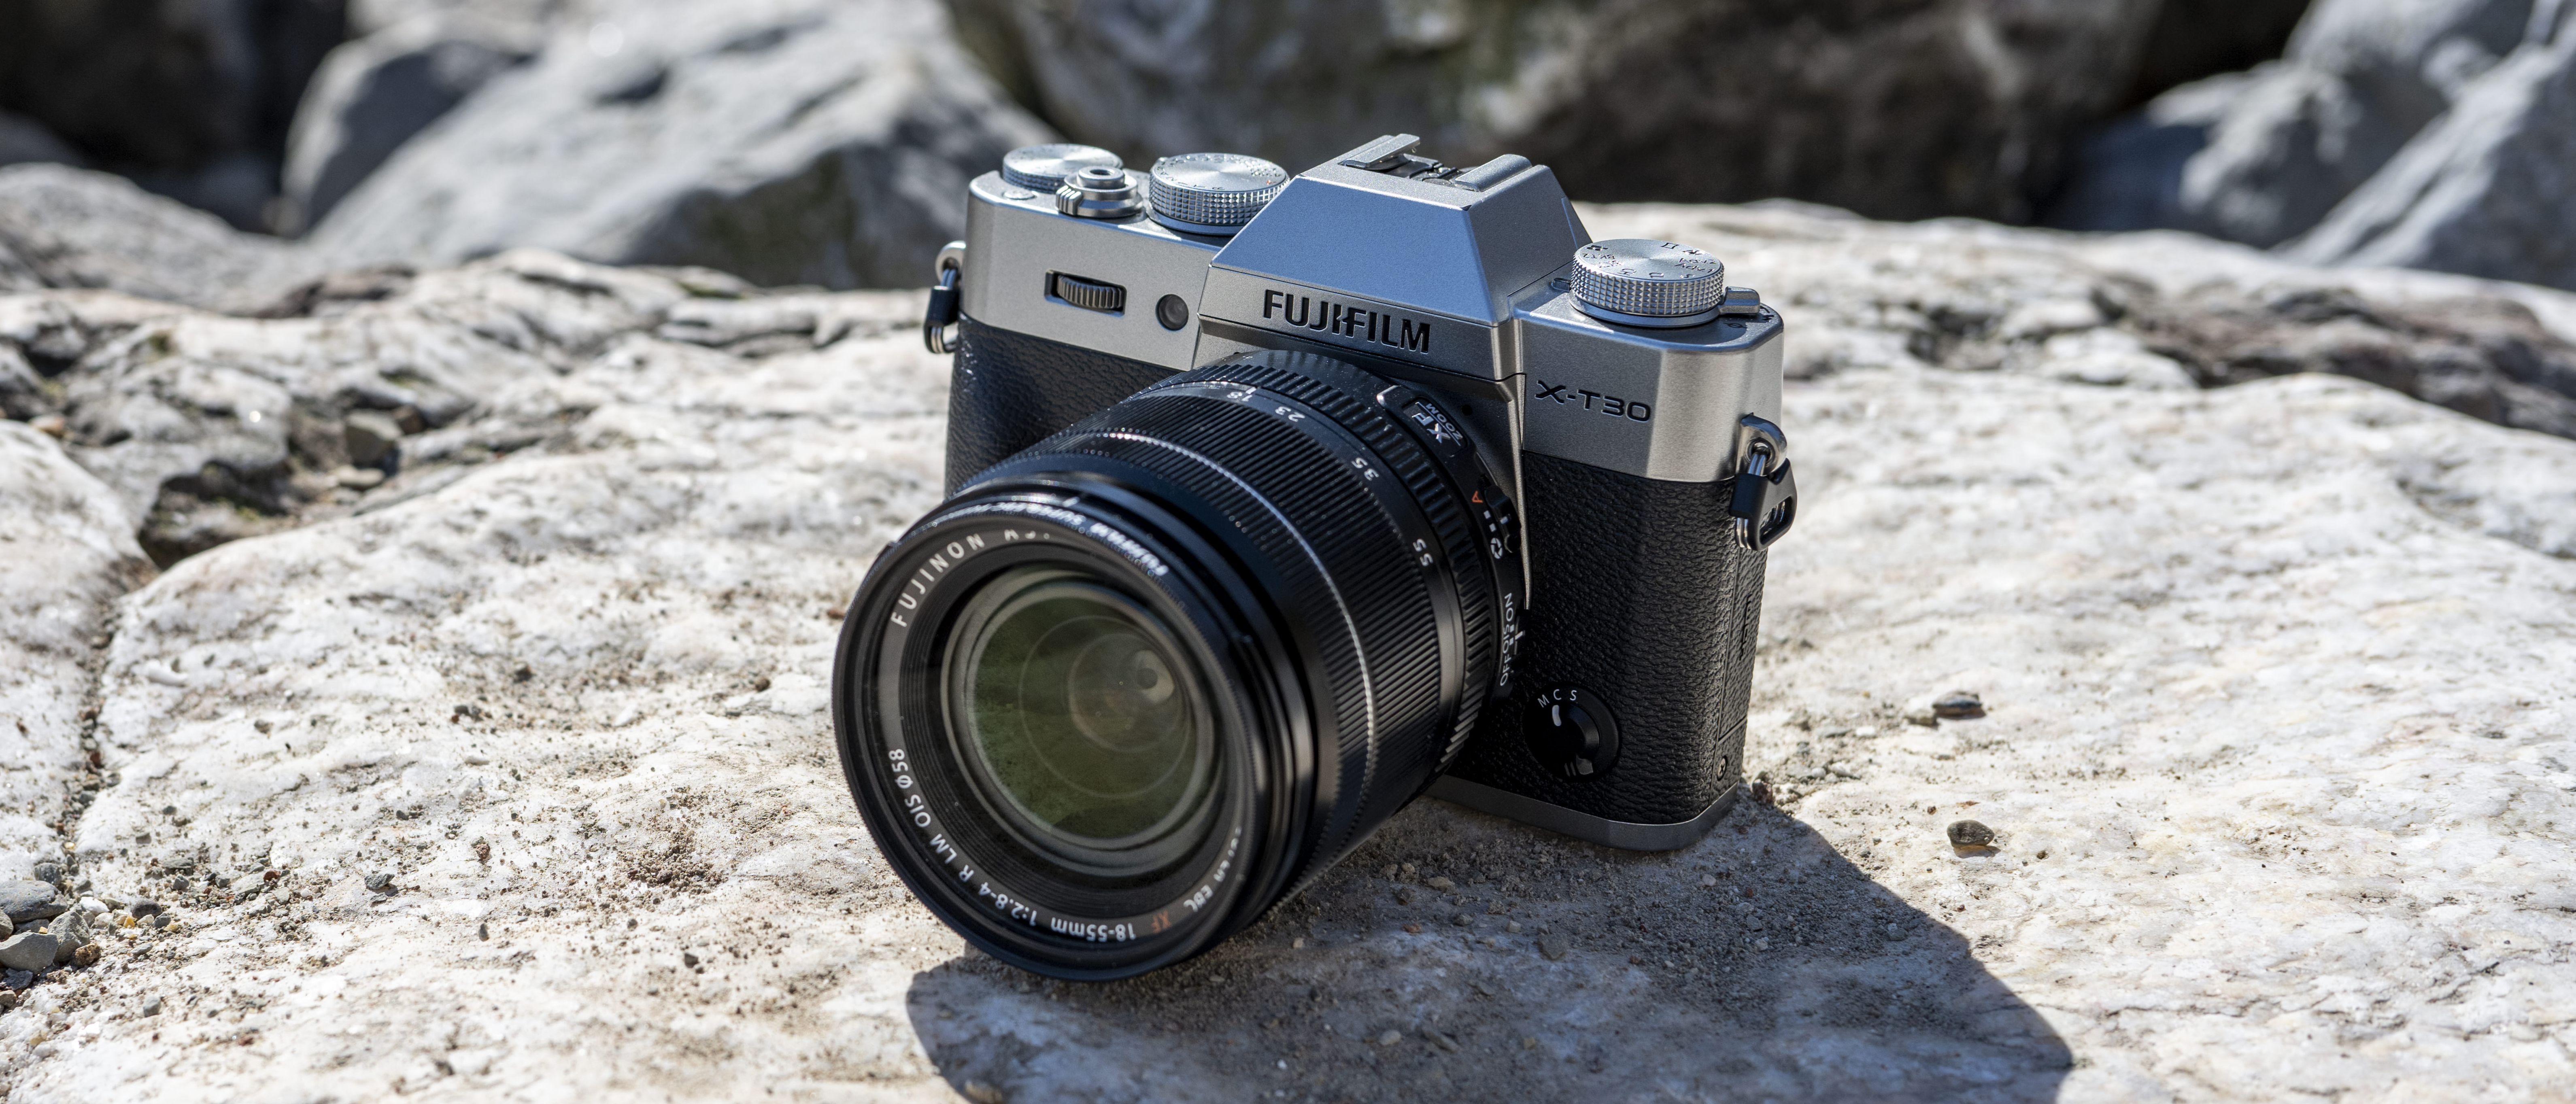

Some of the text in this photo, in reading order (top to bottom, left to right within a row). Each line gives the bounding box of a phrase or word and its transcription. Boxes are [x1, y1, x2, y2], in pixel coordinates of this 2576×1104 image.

[1263, 289, 1431, 354] FUJIFILM
[1275, 406, 1306, 422] 23
[1535, 380, 1651, 422] X-T30
[1411, 413, 1451, 444] XF
[1426, 403, 1463, 440] ZOOM
[1351, 456, 1379, 481] 35
[1472, 490, 1483, 503] A
[1413, 538, 1433, 567] 55
[891, 533, 985, 628] FUJINON
[1504, 592, 1513, 622] ON
[1500, 654, 1512, 686] OFF
[1537, 689, 1577, 708] M C S
[904, 794, 931, 828] OIS
[930, 833, 958, 864] LM
[959, 864, 974, 883] R
[978, 881, 1037, 927] 1:2.8-4
[1051, 917, 1136, 942] 18-55mm
[1151, 910, 1173, 934] XF
